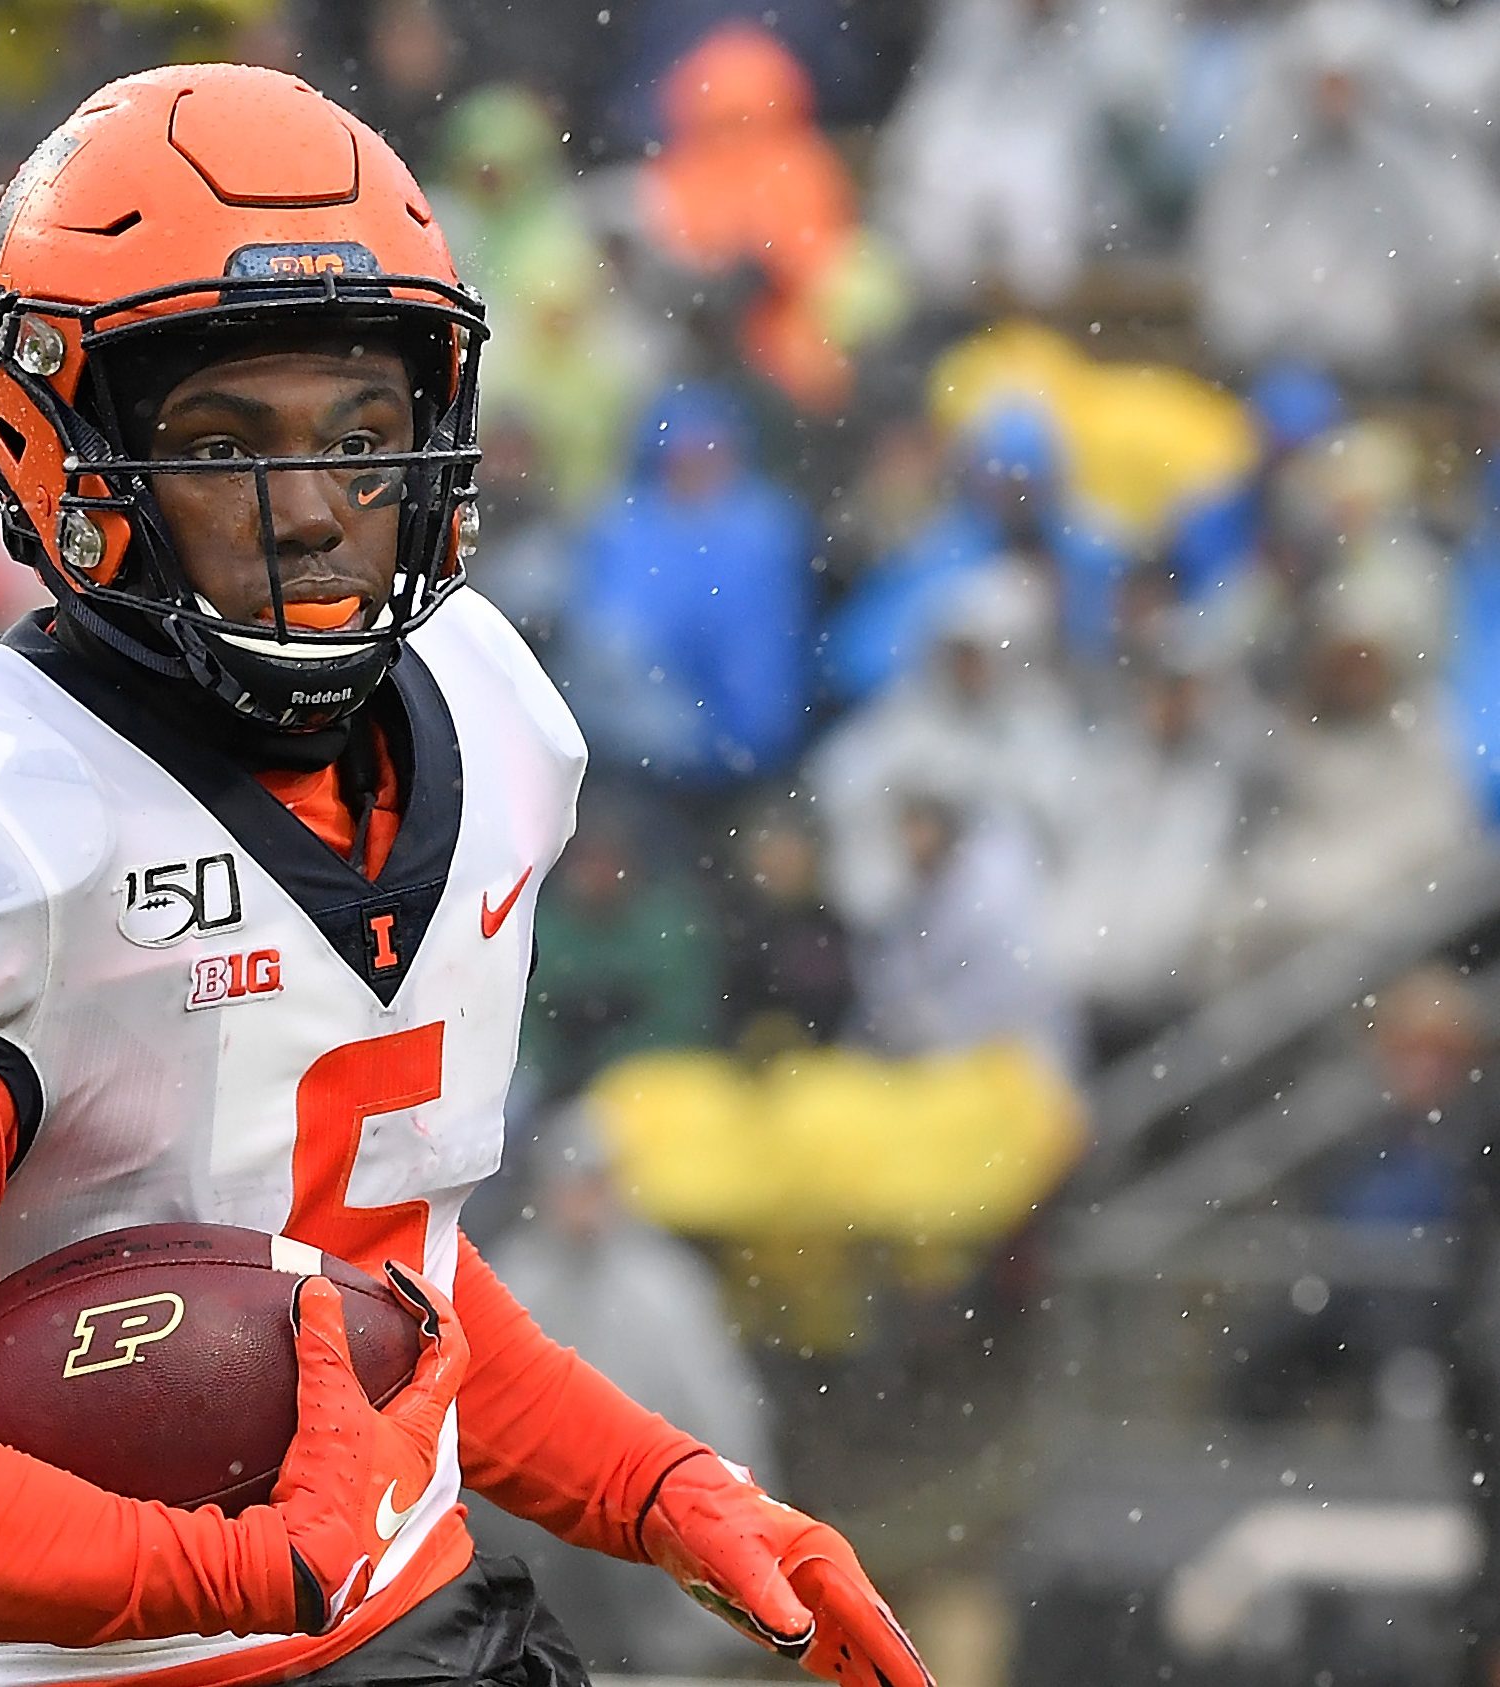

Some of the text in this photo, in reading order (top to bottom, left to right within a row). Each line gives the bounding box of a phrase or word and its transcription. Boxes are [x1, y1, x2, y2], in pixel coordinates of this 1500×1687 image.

[291, 687, 353, 705] Riddell
[117, 852, 243, 946] 150
[370, 914, 398, 969] I
[62, 1292, 186, 1379] P
